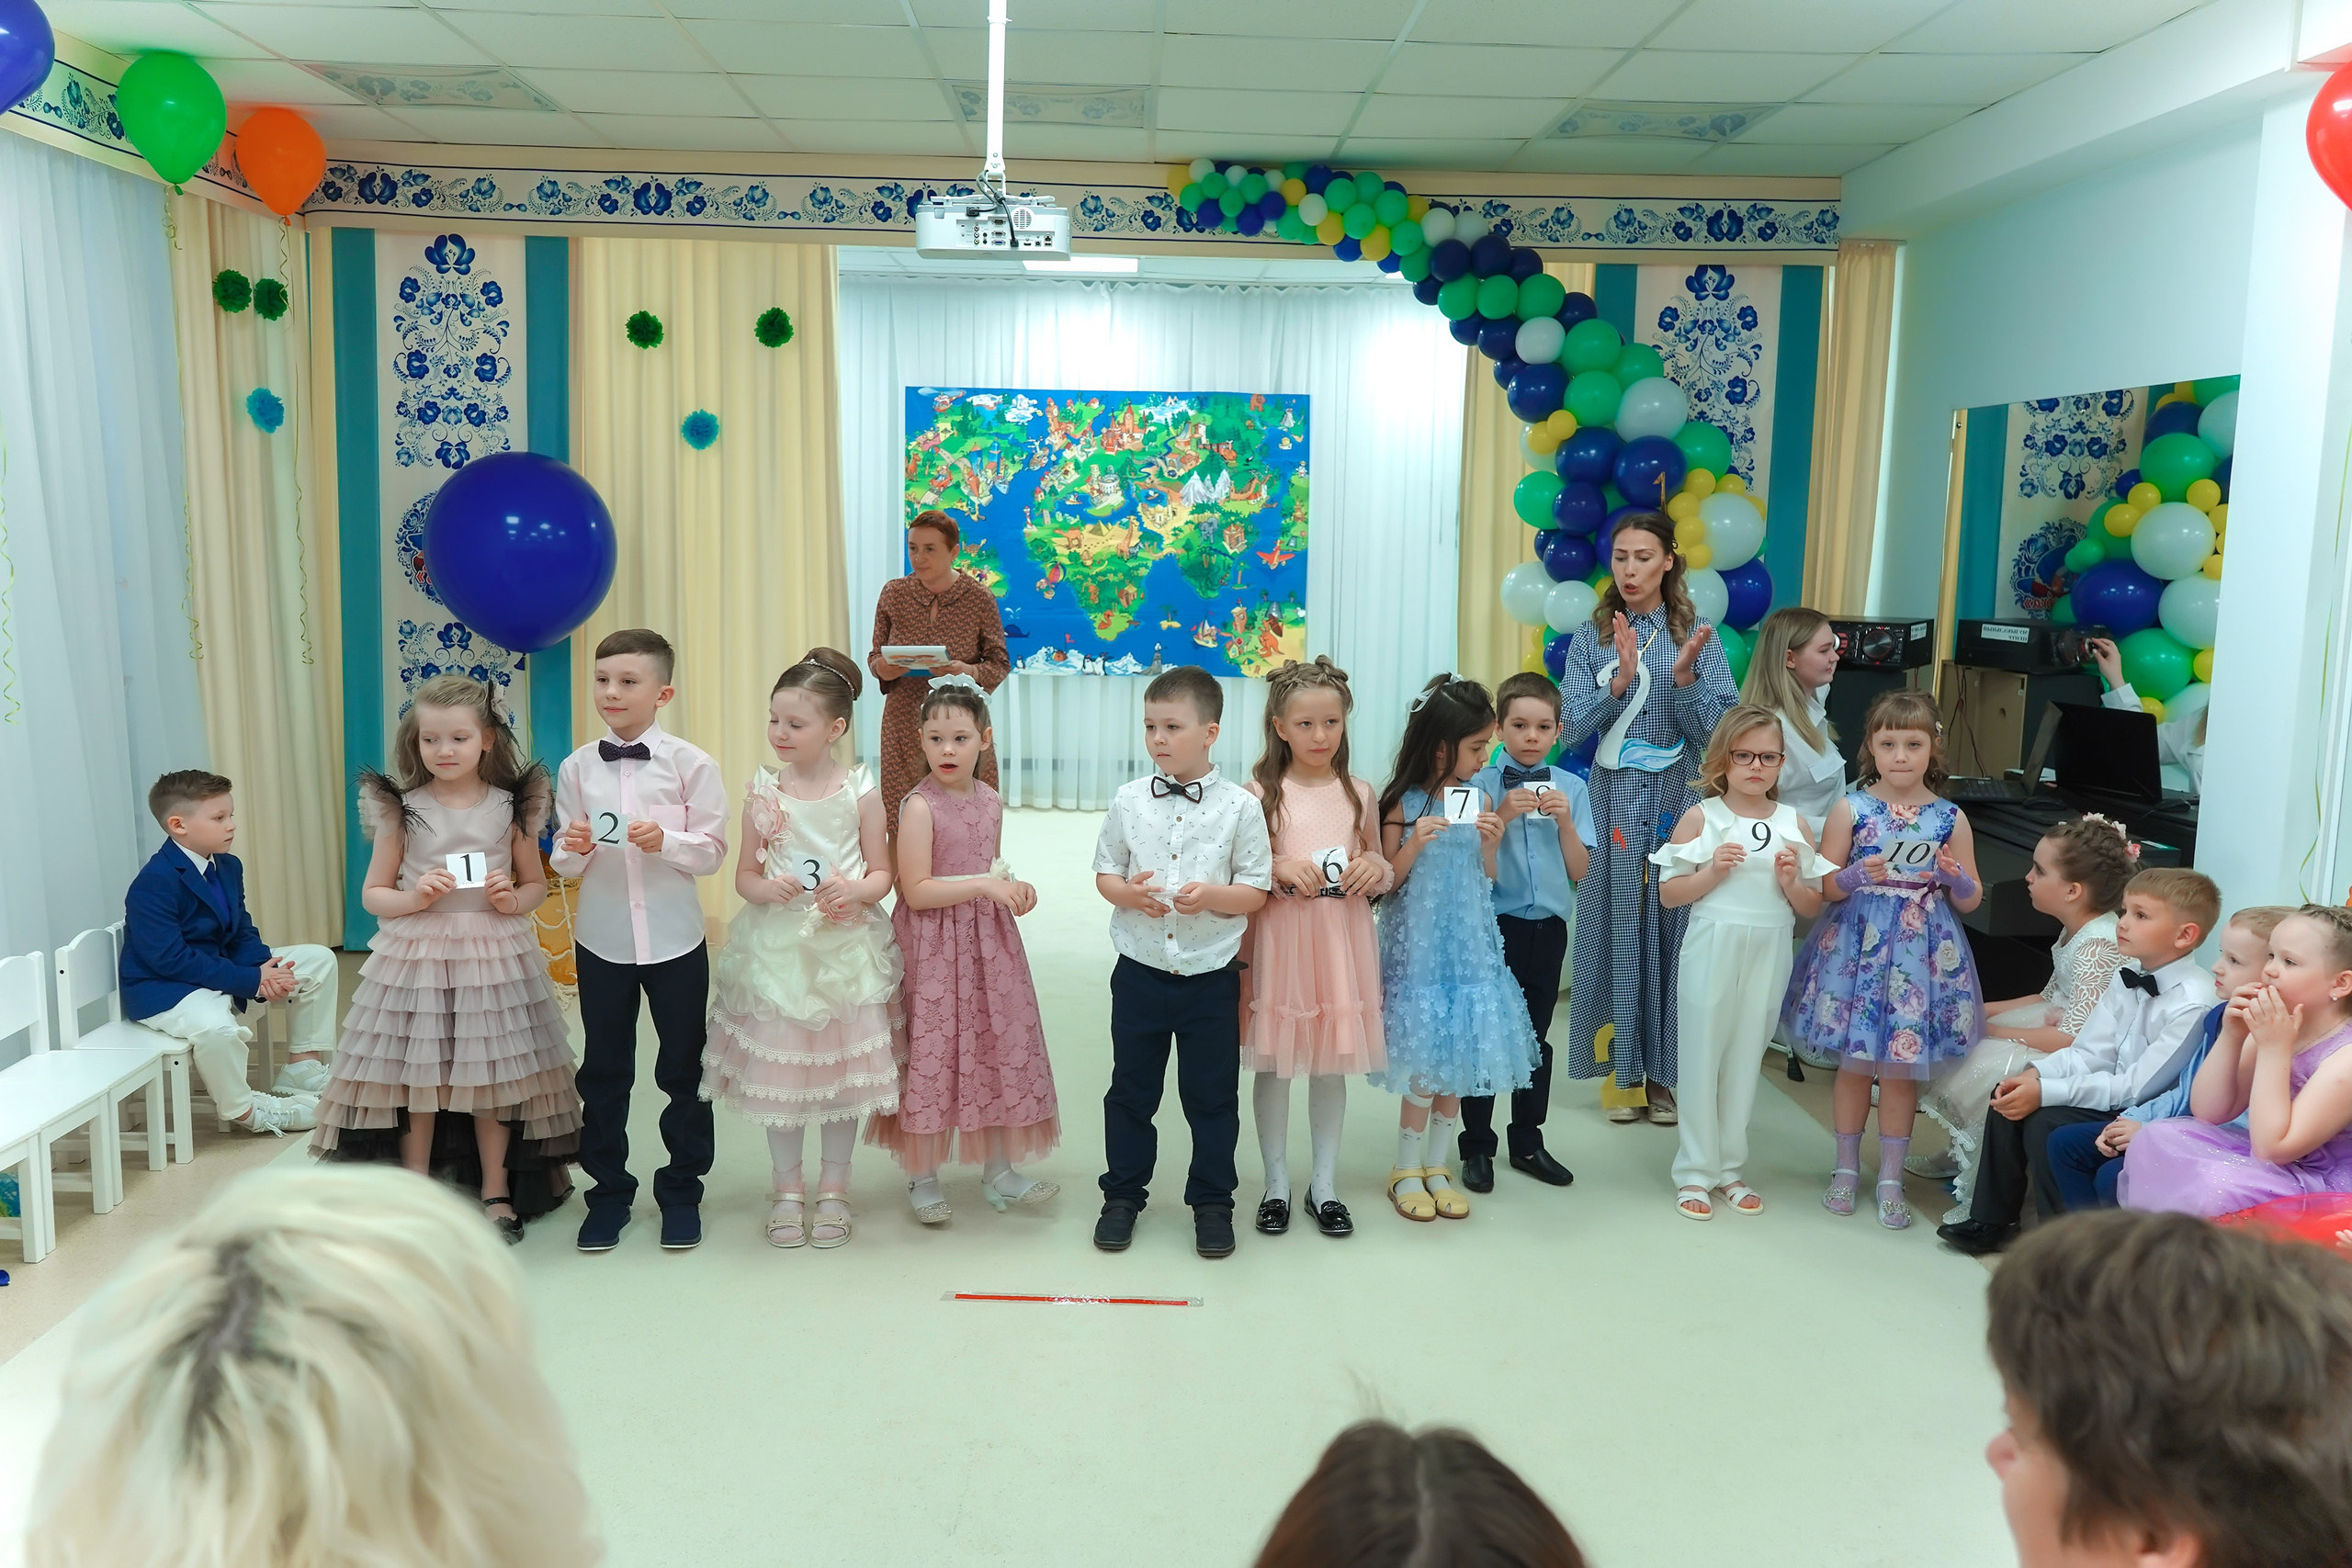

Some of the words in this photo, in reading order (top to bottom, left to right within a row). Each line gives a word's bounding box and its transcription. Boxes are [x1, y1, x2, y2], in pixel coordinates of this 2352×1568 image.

[1451, 788, 1471, 819] 7
[597, 811, 620, 844] 2
[1750, 821, 1771, 852] 9
[1322, 848, 1343, 884] 6
[1886, 840, 1931, 864] 10
[459, 853, 474, 883] 1
[801, 859, 821, 891] 3
